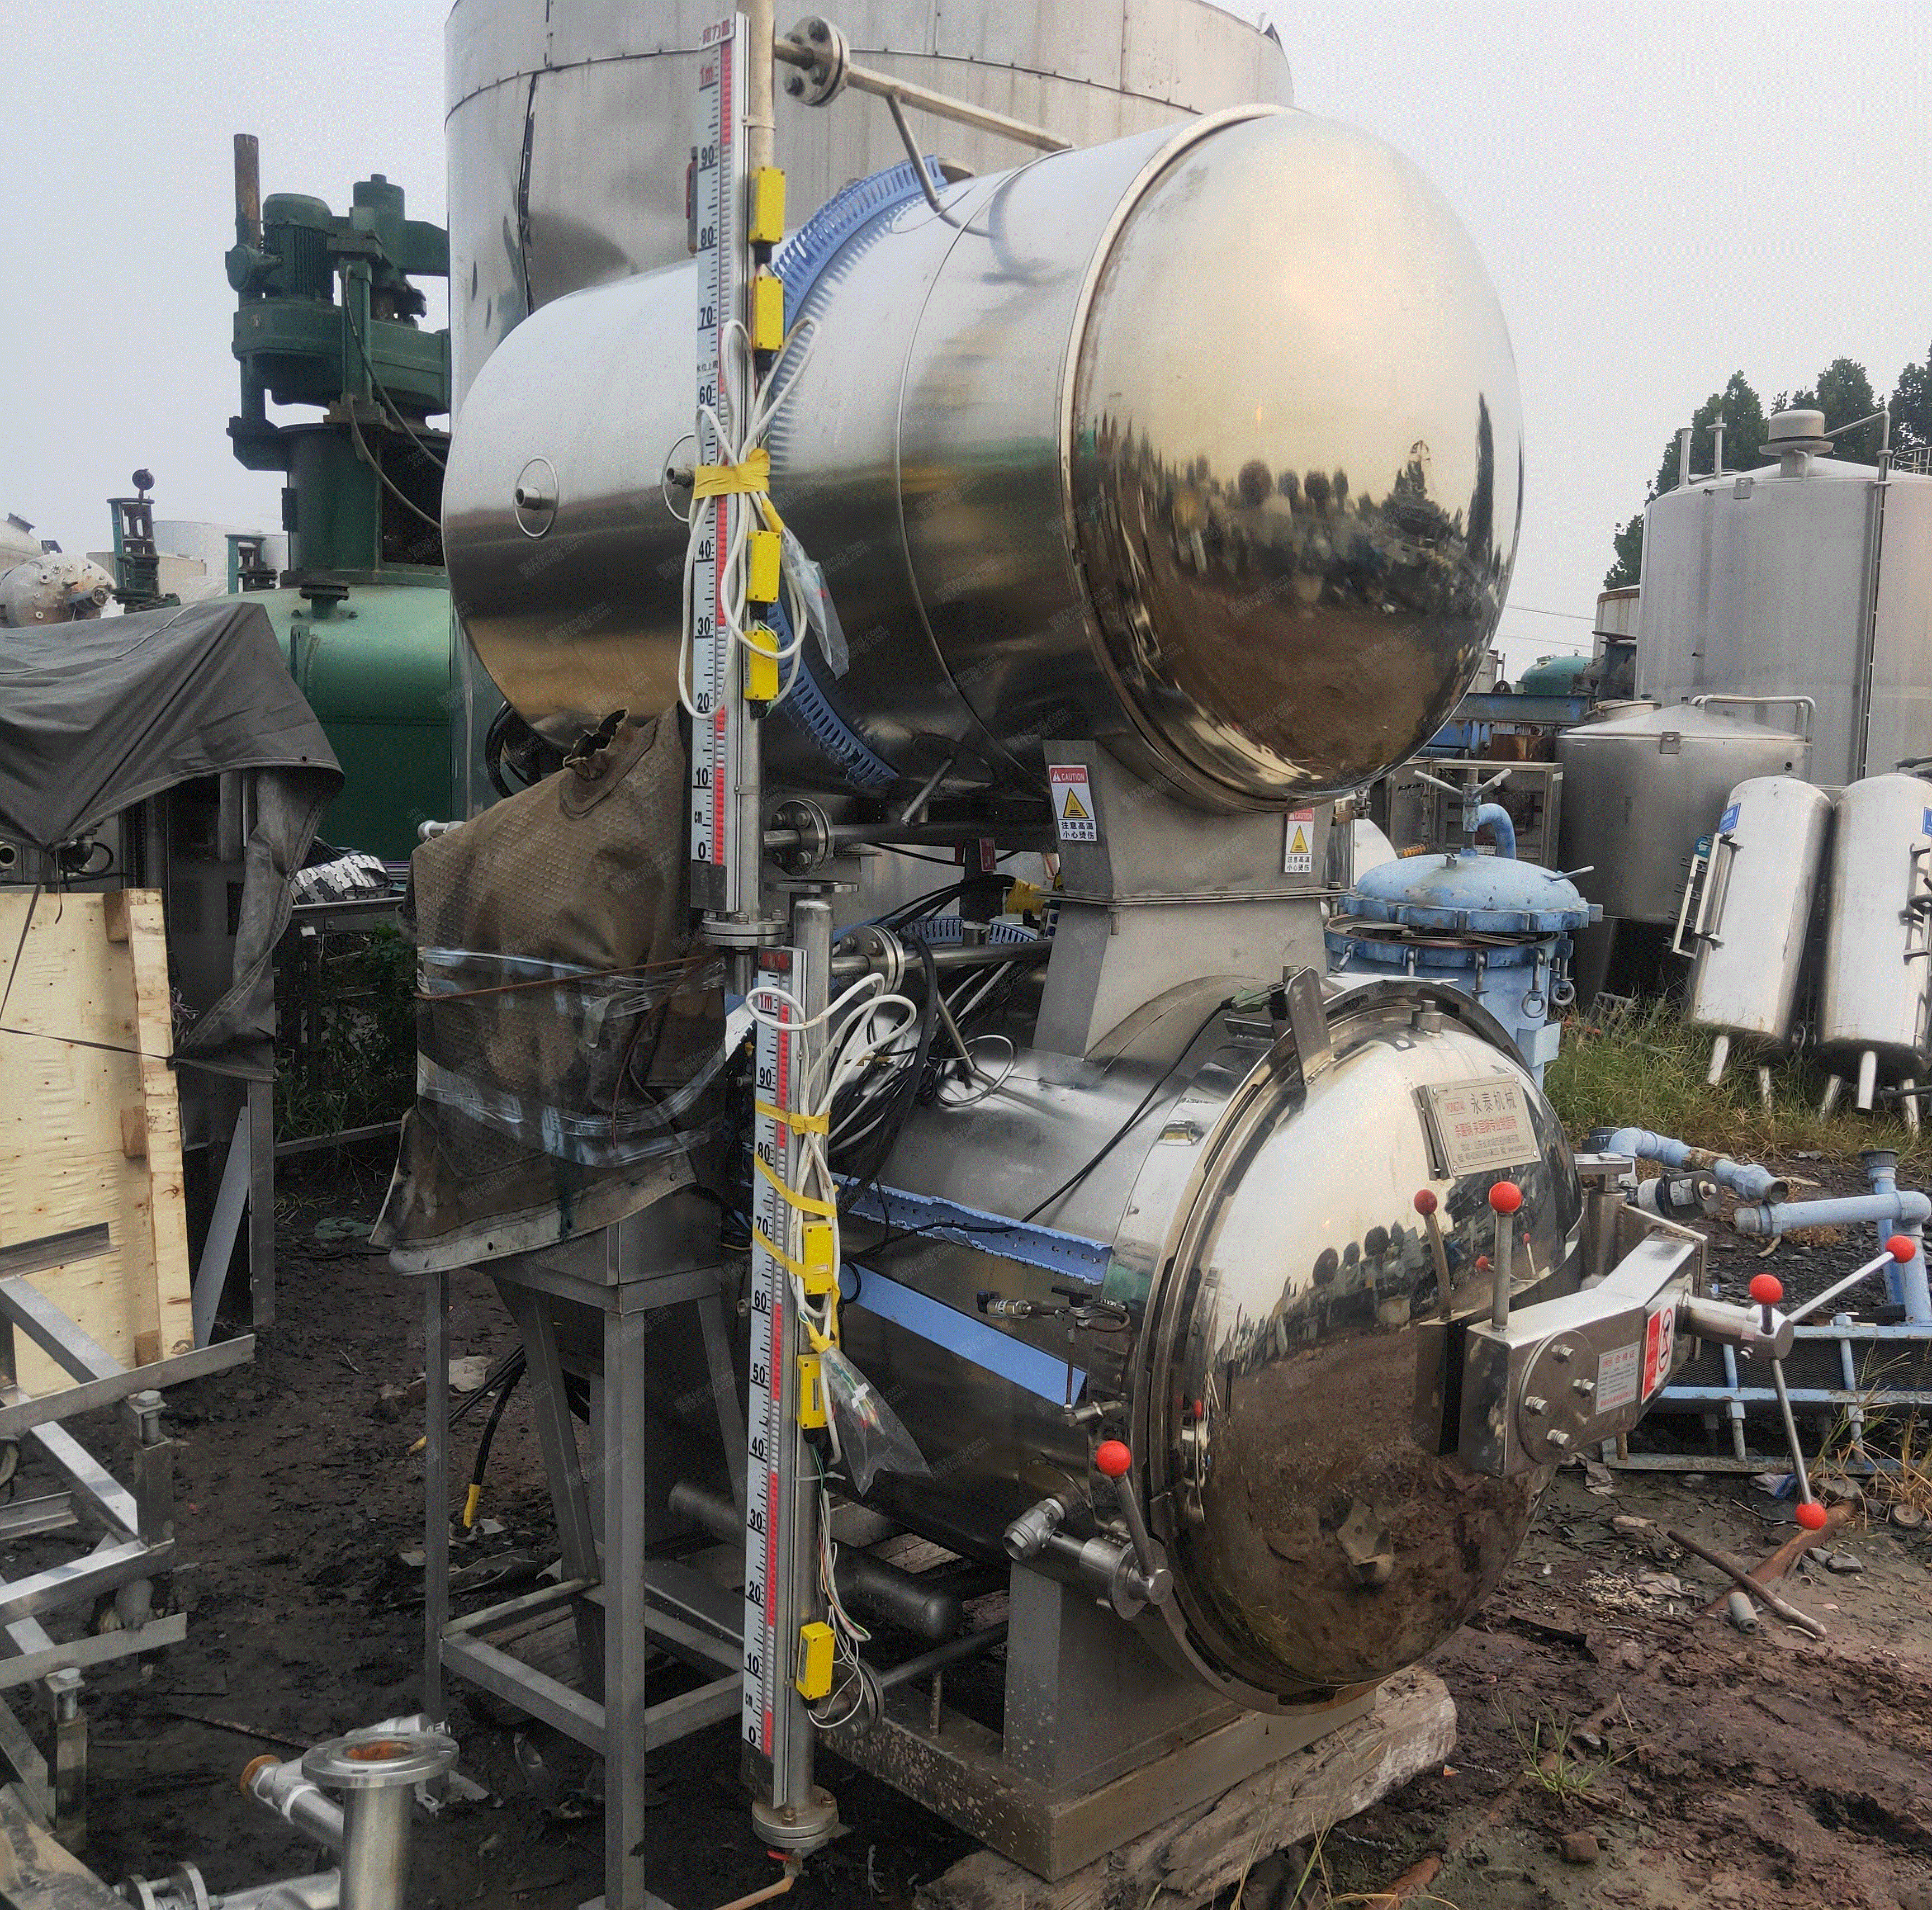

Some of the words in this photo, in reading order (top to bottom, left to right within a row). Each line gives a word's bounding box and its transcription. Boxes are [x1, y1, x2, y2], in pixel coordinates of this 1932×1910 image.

[700, 65, 713, 83] 1m
[701, 145, 714, 167] 90
[700, 226, 714, 247] 80
[700, 306, 713, 327] 70
[699, 385, 712, 405] 60
[698, 540, 711, 559] 40
[698, 617, 711, 635] 30
[698, 693, 709, 710] 20
[696, 768, 708, 786] 10
[1062, 773, 1085, 782] CAUTION
[698, 841, 706, 859] 0
[759, 994, 772, 1010] 1m
[759, 1067, 772, 1087] 90
[1471, 1089, 1517, 1114] 永泰机械
[757, 1142, 770, 1162] 80
[756, 1216, 768, 1236] 70
[754, 1290, 767, 1310] 60
[752, 1363, 765, 1384] 50
[752, 1437, 764, 1457] 40
[750, 1509, 763, 1530] 30
[749, 1581, 761, 1601] 20
[747, 1652, 760, 1673] 10
[749, 1726, 756, 1744] 0
